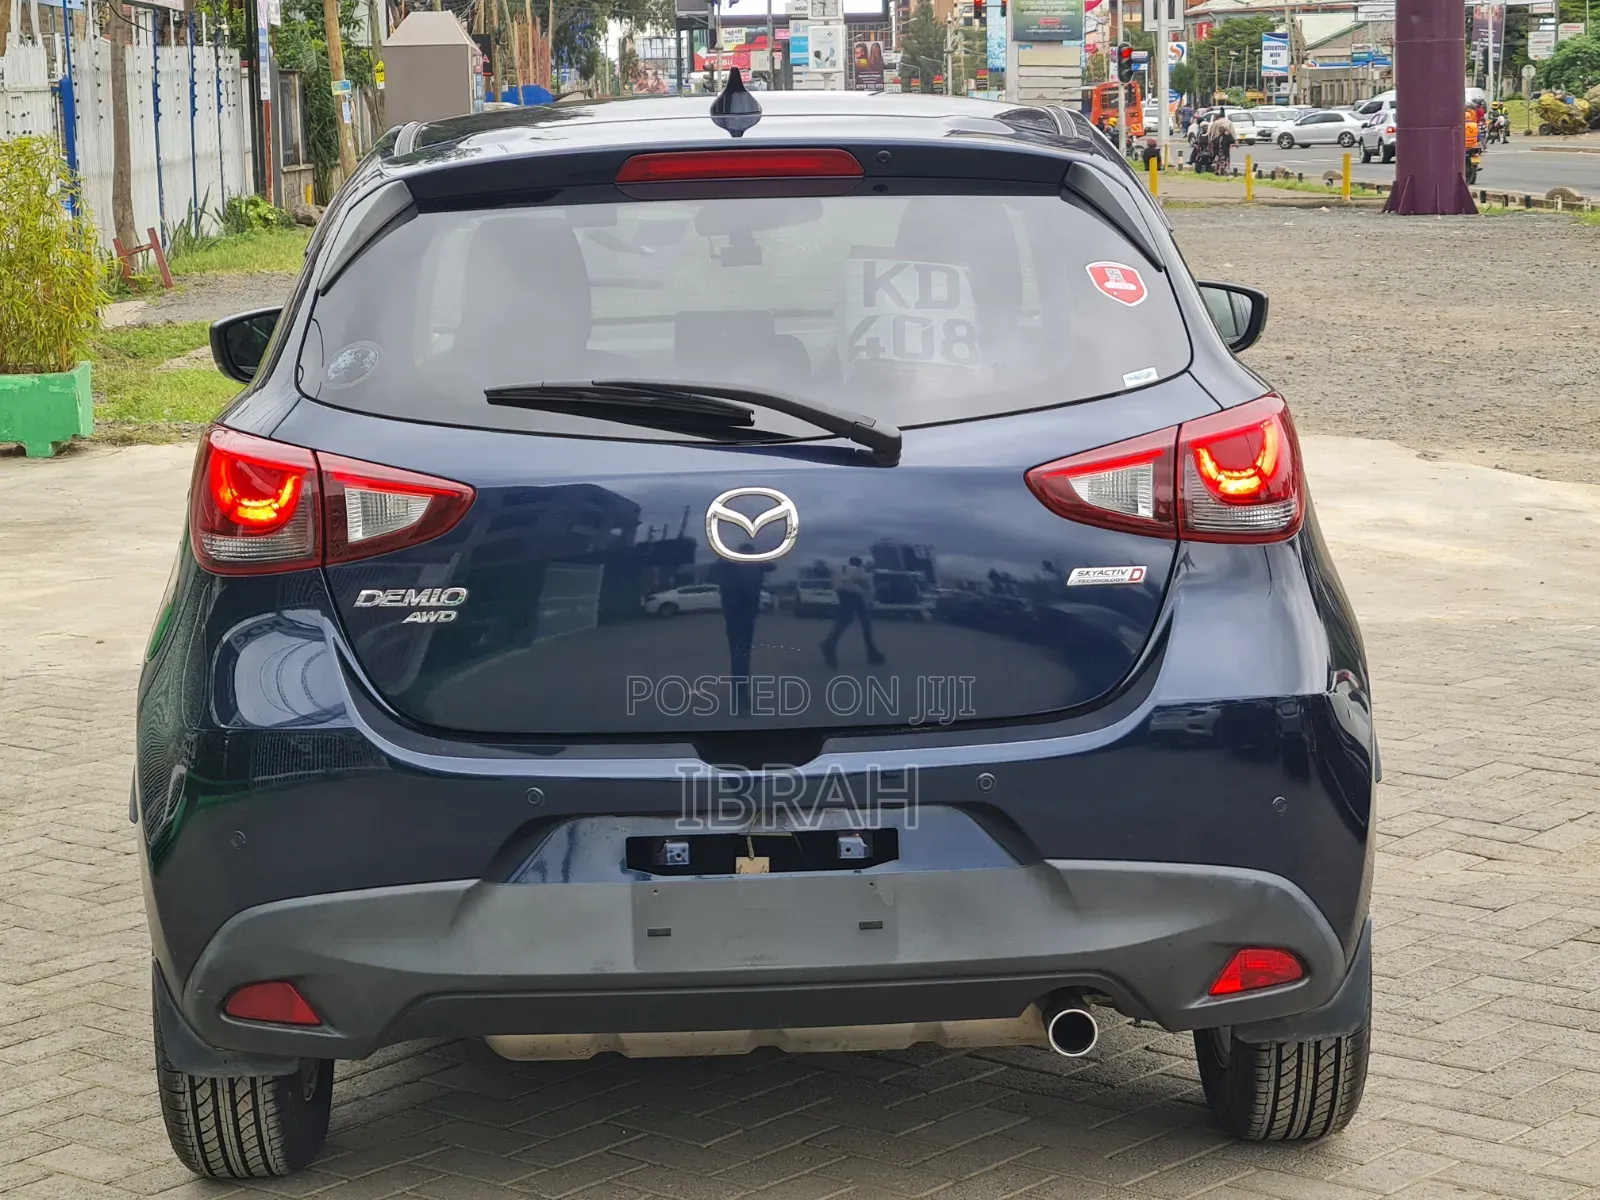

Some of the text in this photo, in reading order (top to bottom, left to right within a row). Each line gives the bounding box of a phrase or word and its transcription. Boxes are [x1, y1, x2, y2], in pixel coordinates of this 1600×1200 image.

[847, 314, 980, 363] 408
[1076, 568, 1128, 576] SKYACTIV
[353, 586, 469, 607] DEMIO
[401, 610, 458, 624] AWD
